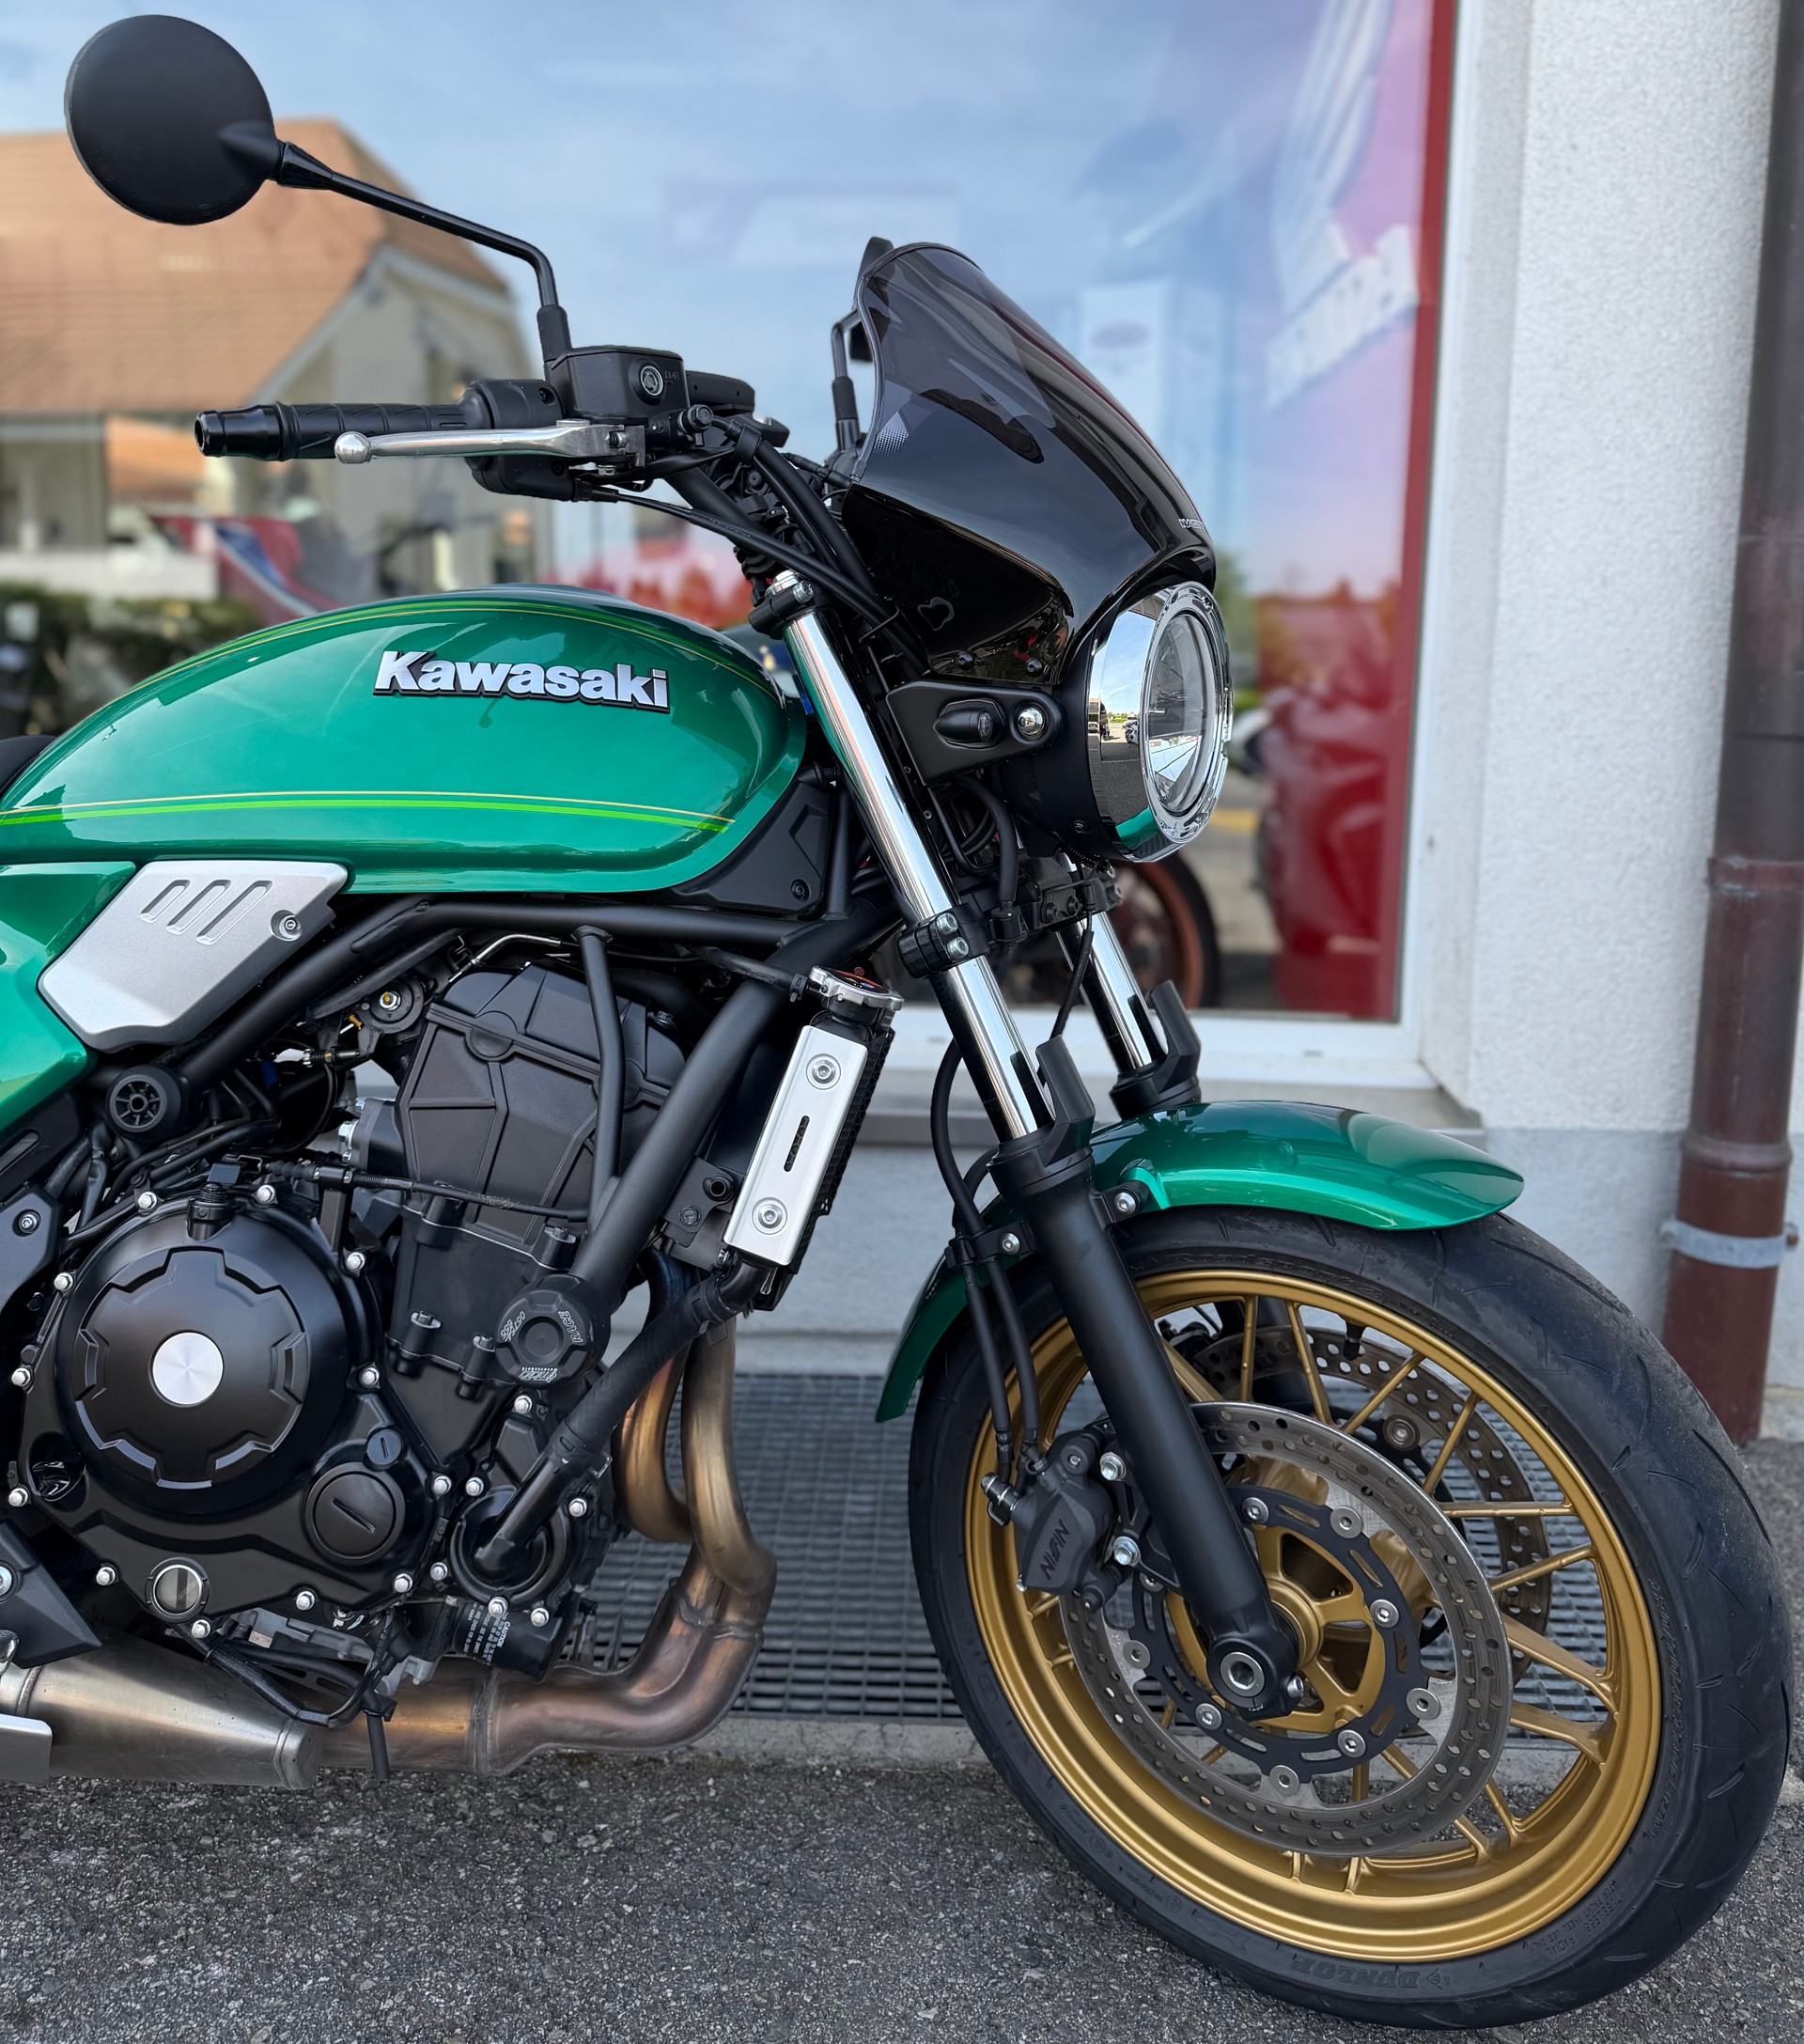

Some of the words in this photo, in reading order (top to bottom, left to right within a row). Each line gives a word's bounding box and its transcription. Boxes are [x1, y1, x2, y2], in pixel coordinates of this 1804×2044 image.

[374, 650, 670, 710] Kawasaki
[558, 1310, 583, 1343] RACE
[1039, 1515, 1071, 1581] NISSIN
[496, 1621, 511, 1648] CAUTION
[1545, 1932, 1577, 1957] RADIAL
[1290, 1959, 1422, 1989] DUNLOP
